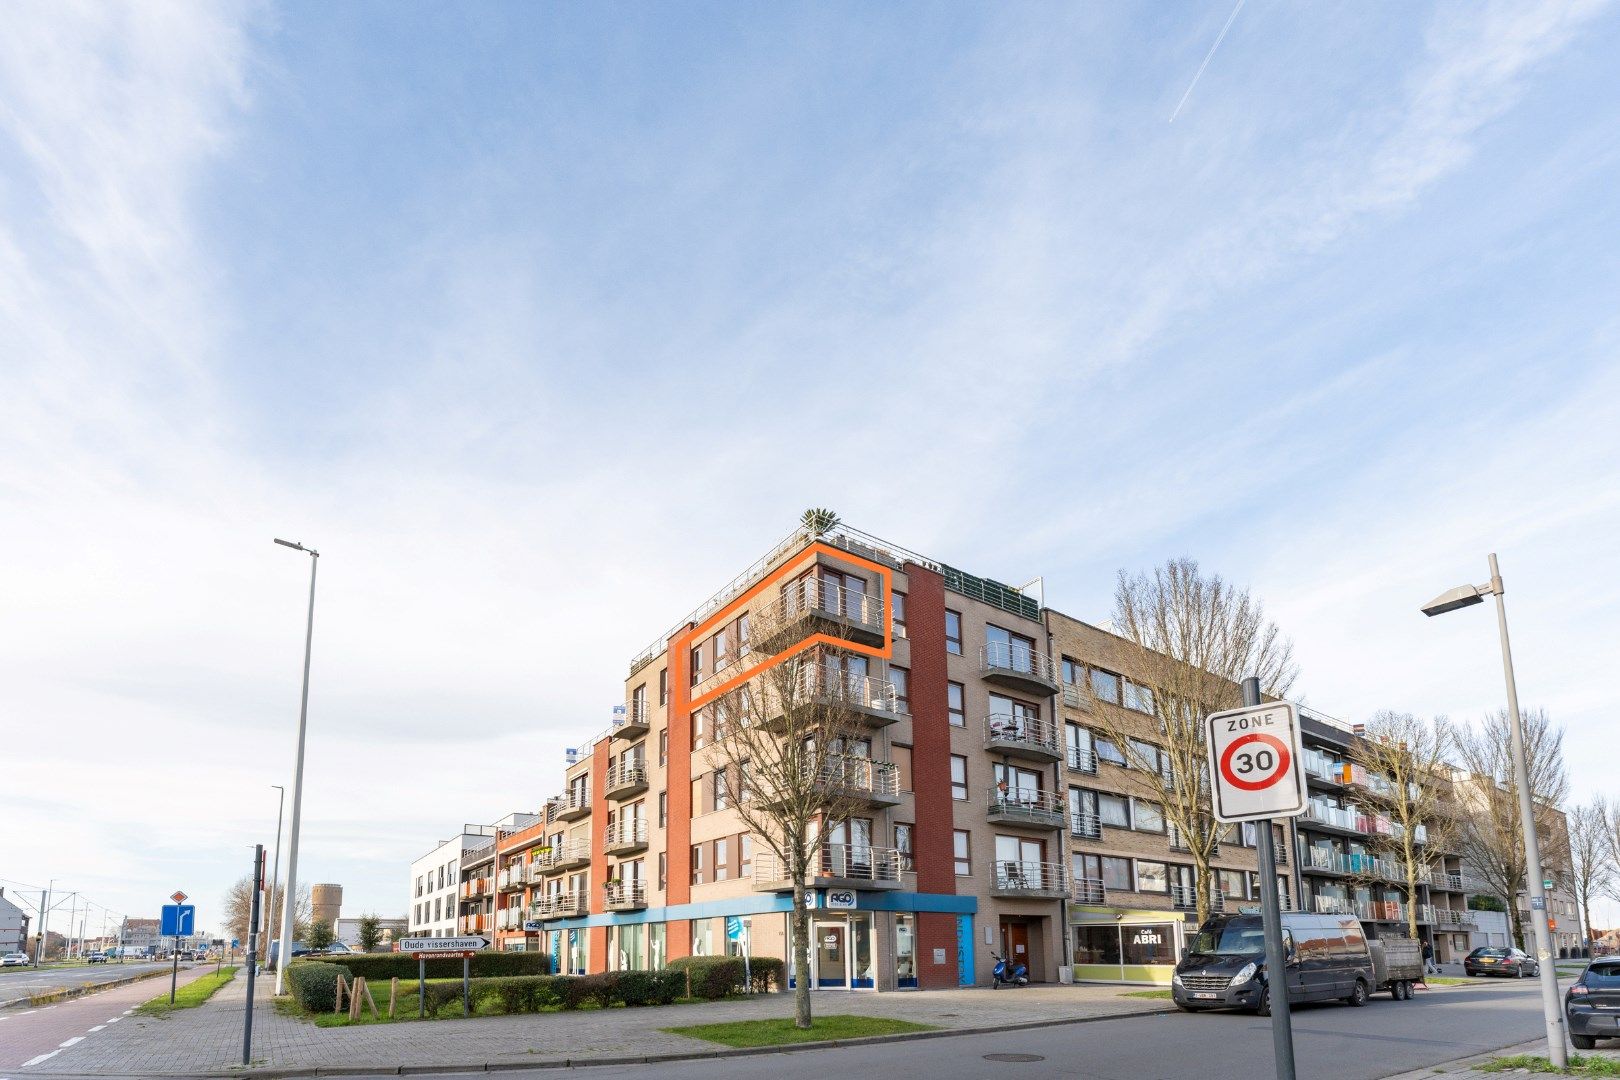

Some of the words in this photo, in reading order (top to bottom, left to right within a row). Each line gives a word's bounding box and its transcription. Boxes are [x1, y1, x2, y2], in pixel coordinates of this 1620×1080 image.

[1227, 713, 1274, 732] ZONE
[1236, 750, 1274, 774] 30
[831, 892, 852, 903] AGO
[404, 940, 424, 950] Oude
[427, 939, 477, 949] vissershaven
[1133, 935, 1162, 944] ABRI
